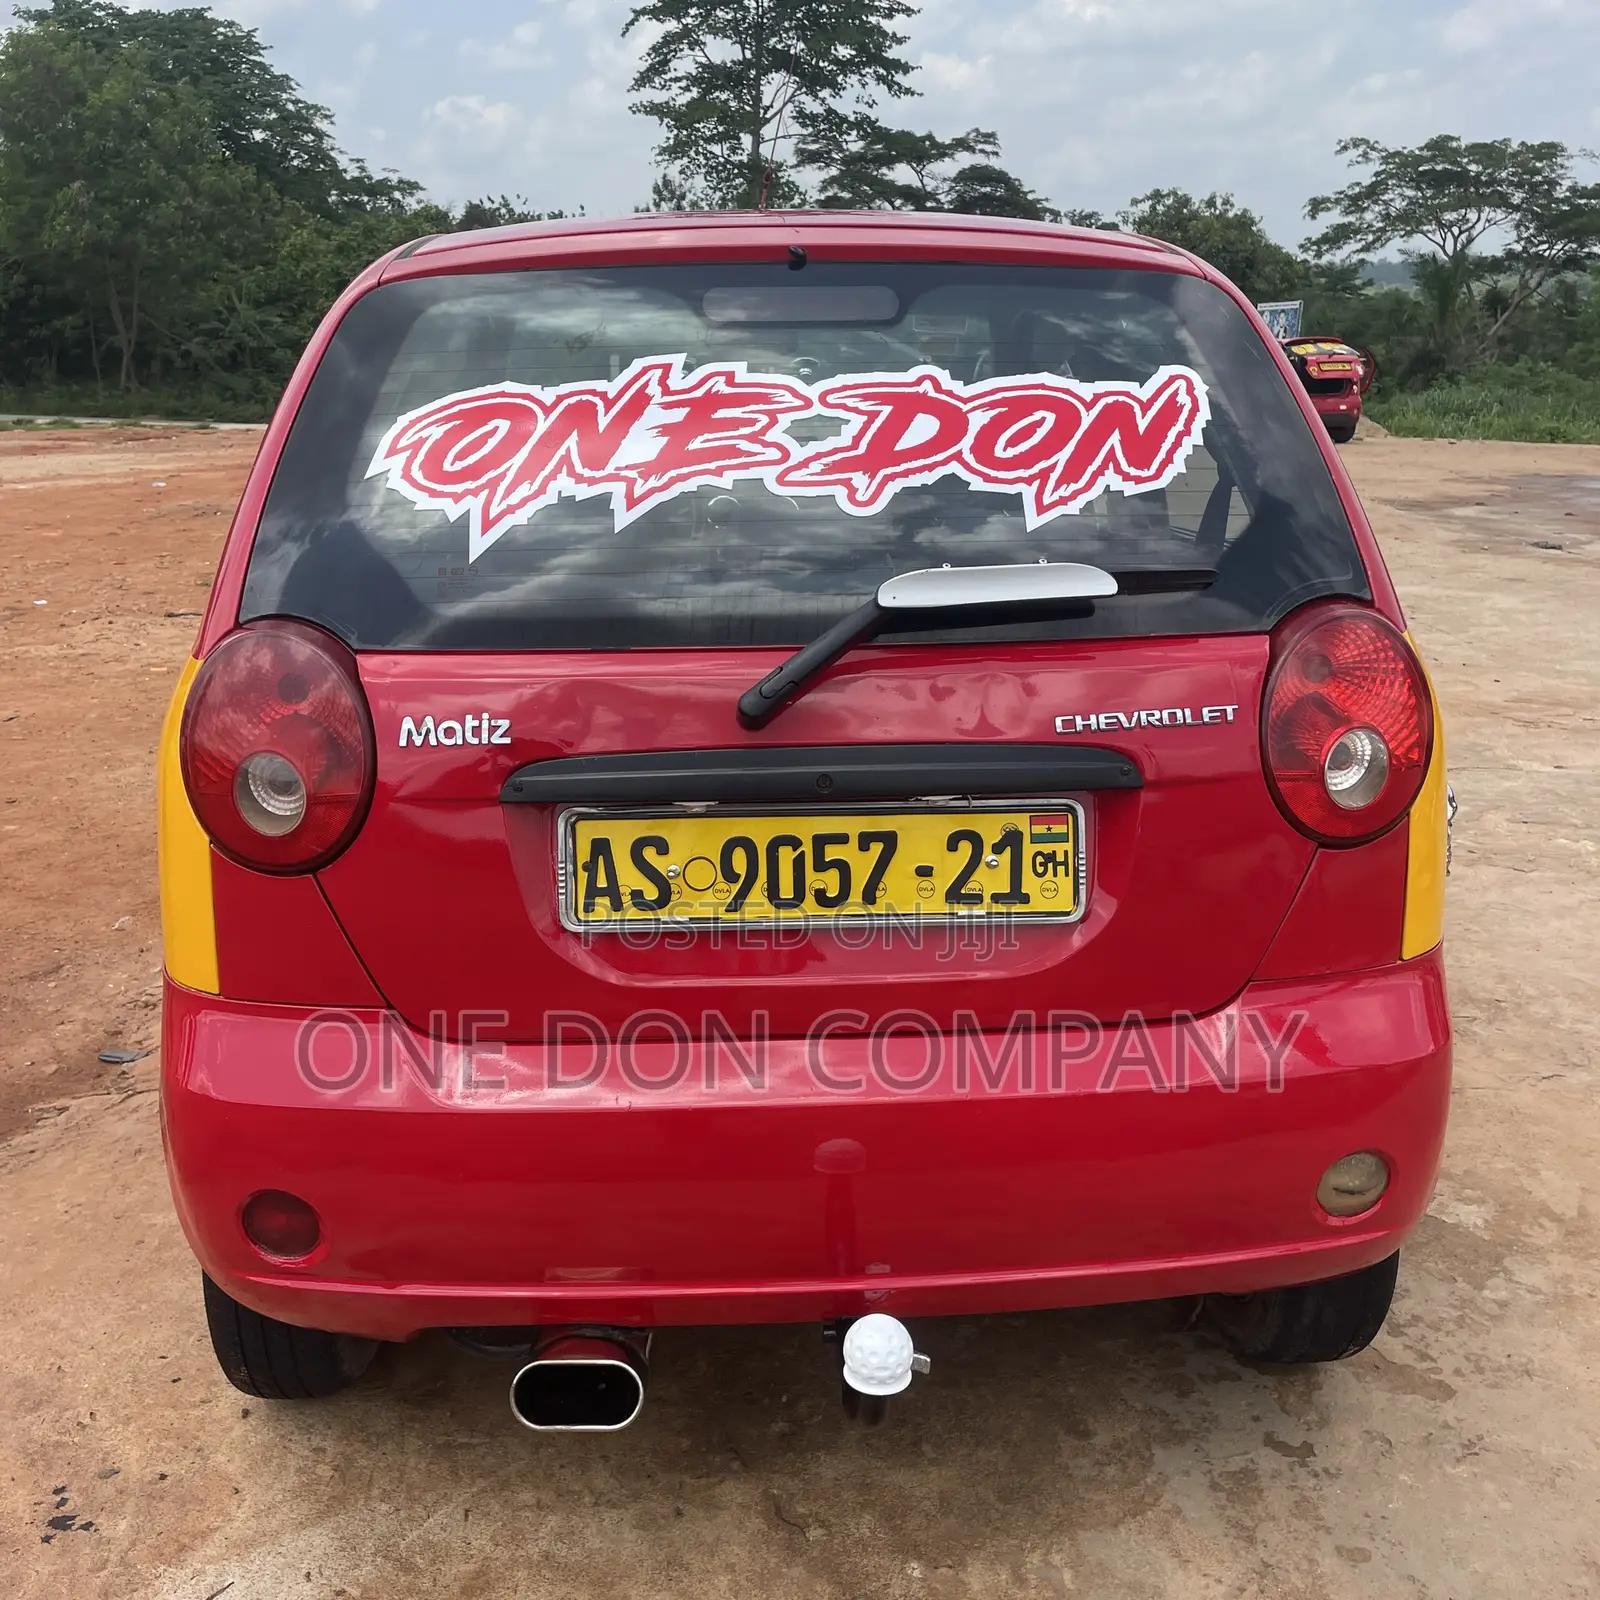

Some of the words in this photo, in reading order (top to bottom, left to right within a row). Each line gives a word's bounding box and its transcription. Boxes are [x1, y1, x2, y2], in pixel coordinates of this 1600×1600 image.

[384, 362, 812, 538] ONE
[776, 374, 1200, 517] DON
[398, 711, 512, 747] Matiz
[1054, 704, 1239, 735] CHEVROLET
[582, 836, 672, 913] AS
[1031, 849, 1070, 878] GH
